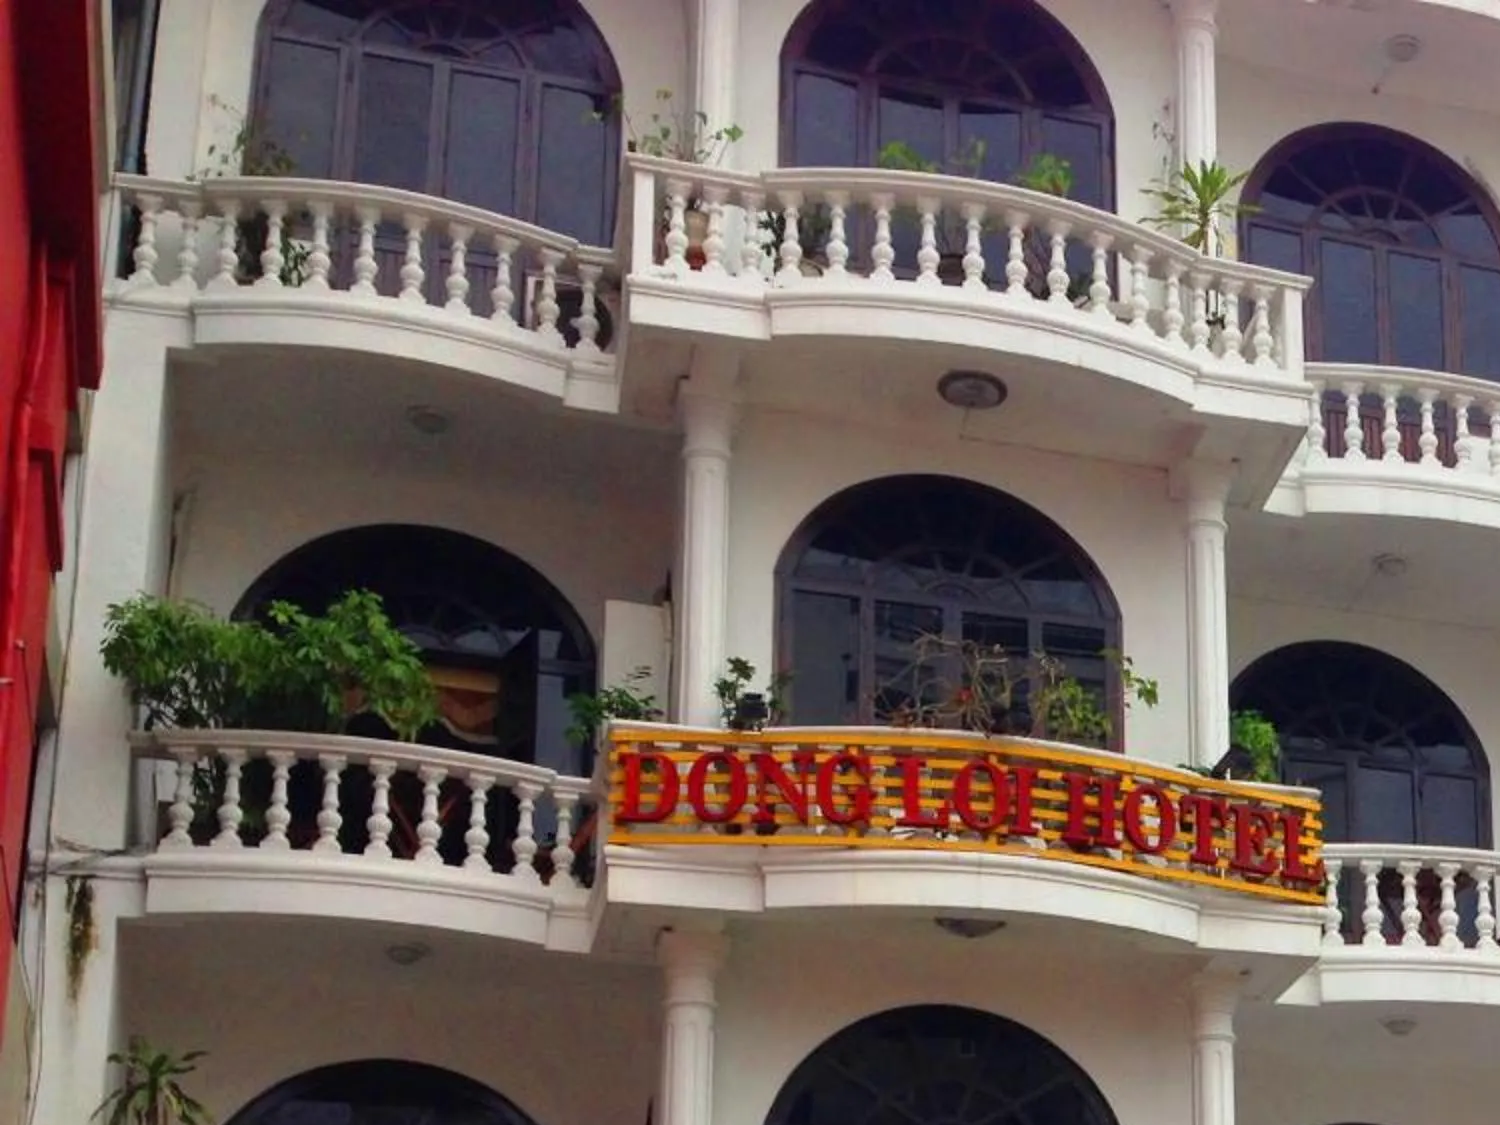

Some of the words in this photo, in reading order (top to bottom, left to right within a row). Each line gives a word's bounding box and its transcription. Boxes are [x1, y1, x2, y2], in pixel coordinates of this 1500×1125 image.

[615, 751, 878, 825] DONG
[896, 752, 1040, 838] LOI
[1061, 768, 1326, 887] HOTEL
